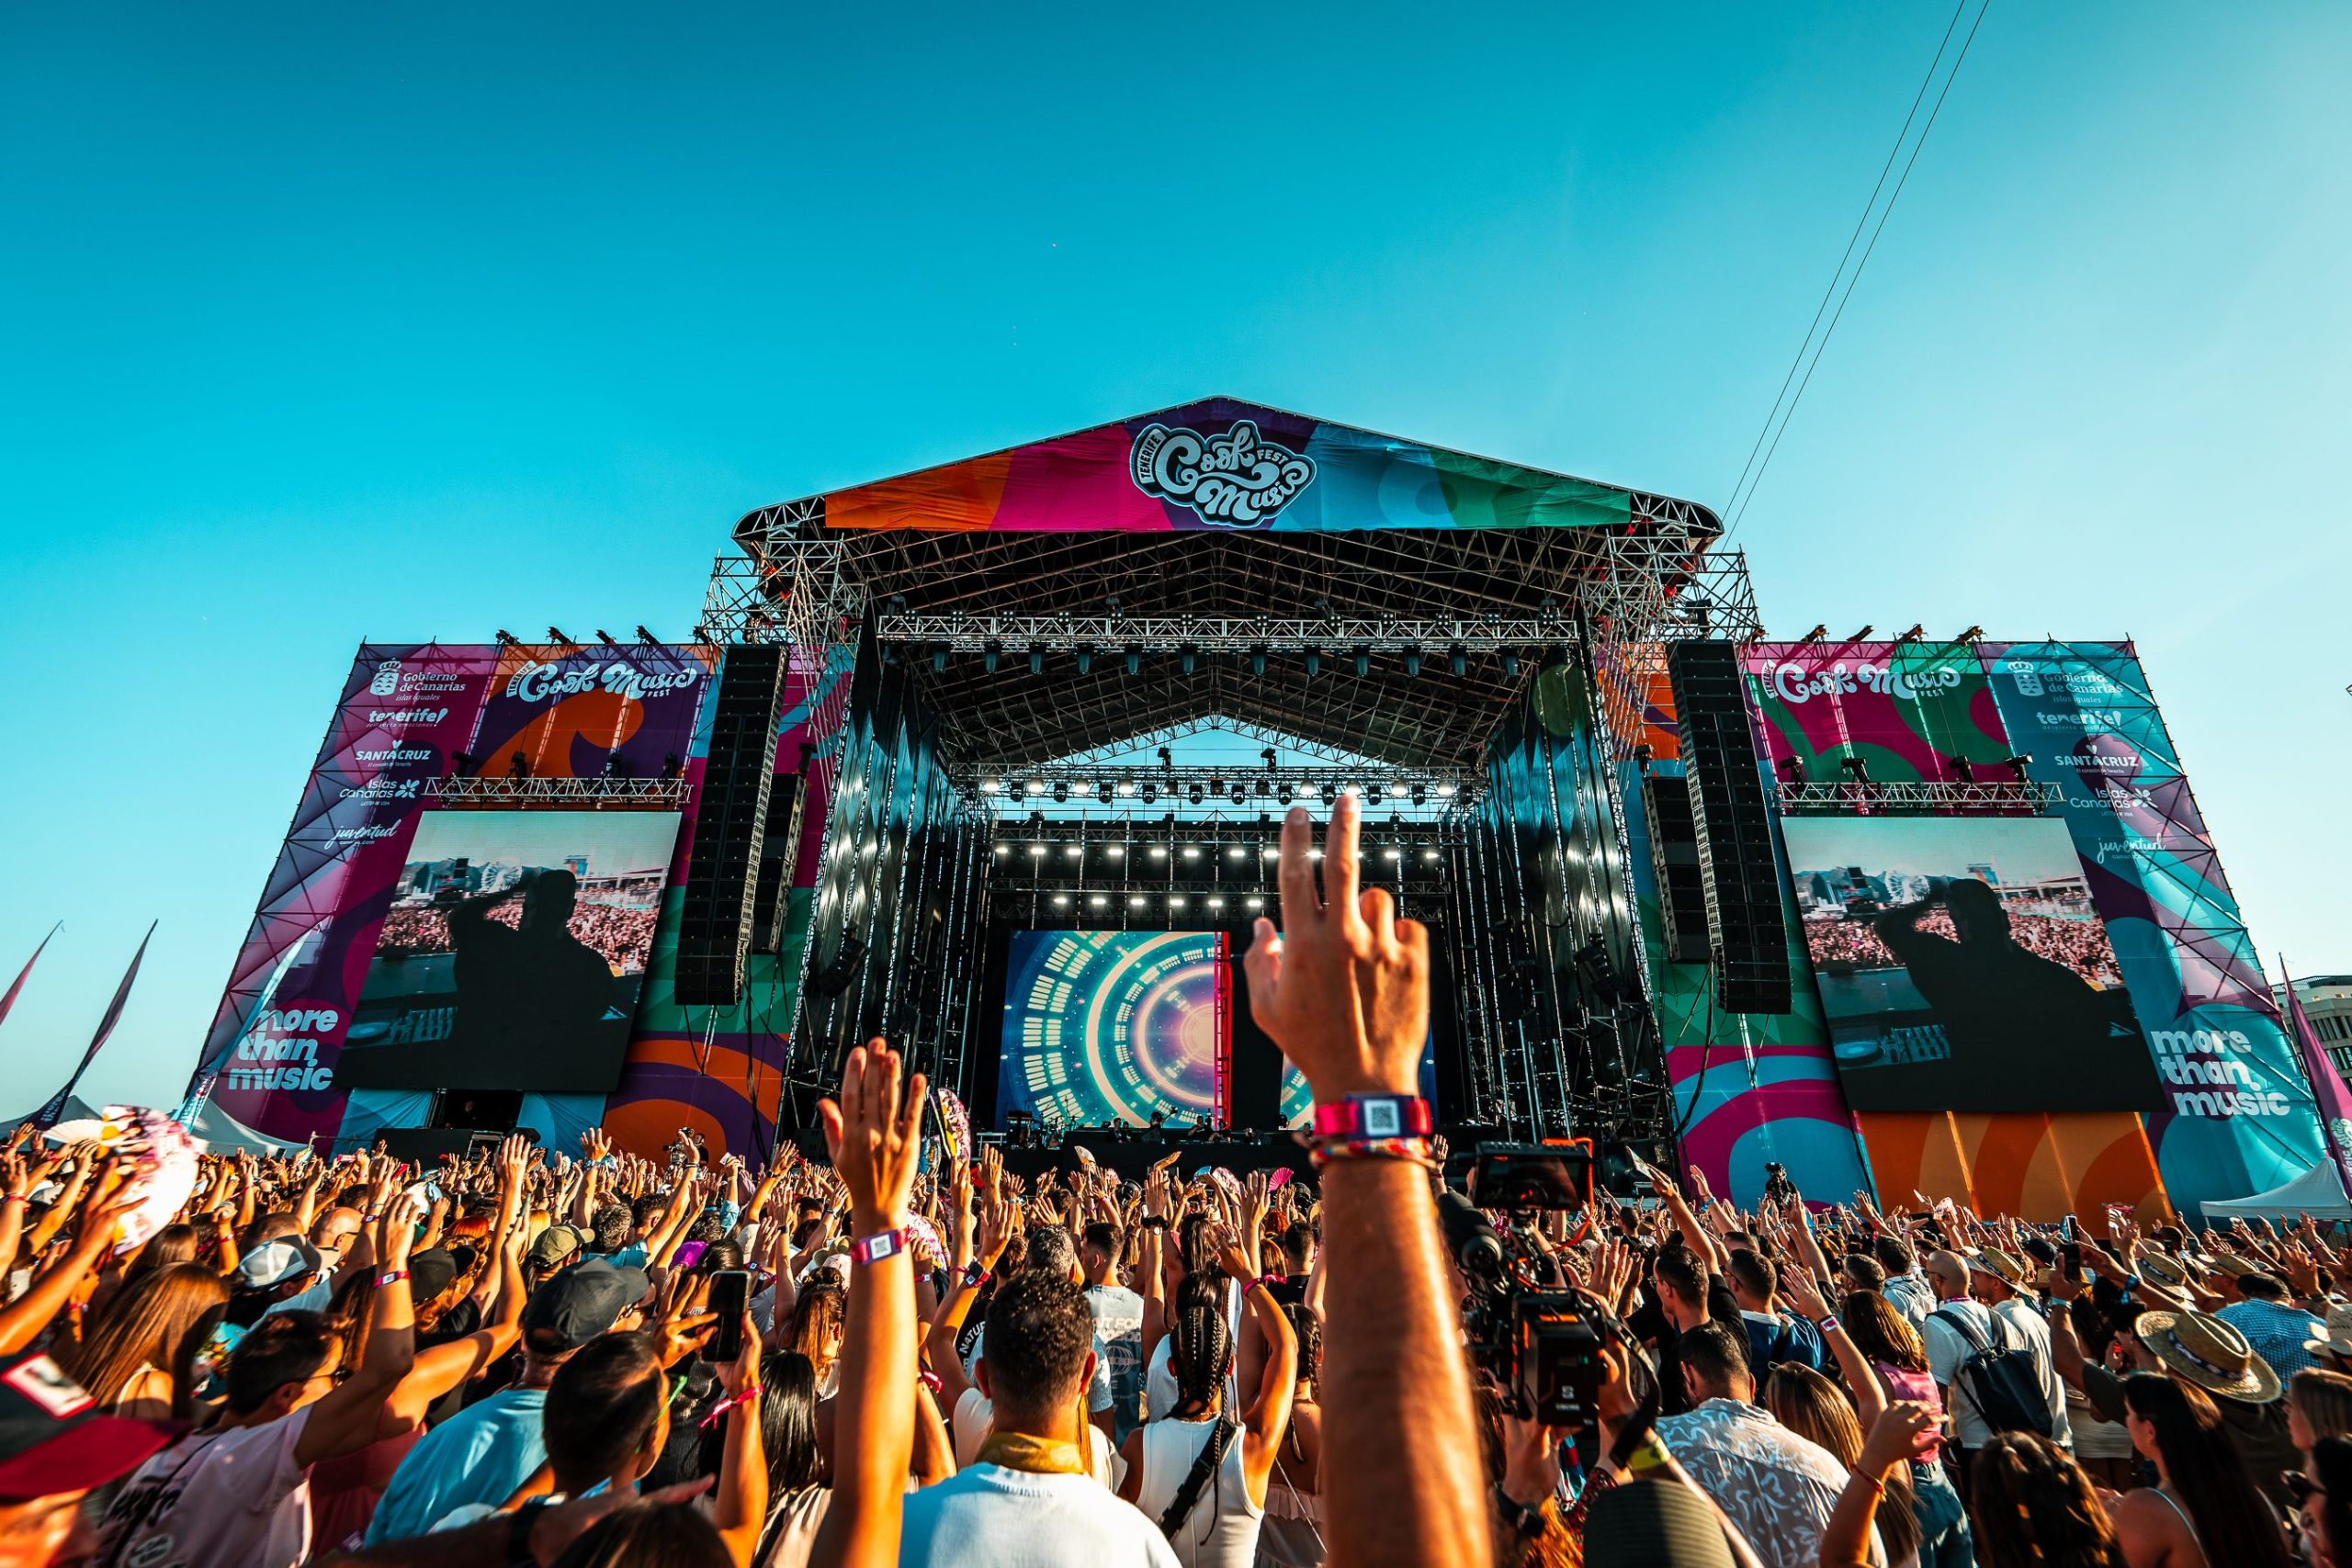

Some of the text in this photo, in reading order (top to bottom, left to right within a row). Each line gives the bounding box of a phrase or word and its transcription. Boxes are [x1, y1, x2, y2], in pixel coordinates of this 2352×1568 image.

[1138, 434, 1161, 479] TENERIFE
[1155, 426, 1257, 494] Cook
[1256, 448, 1288, 464] FEST
[1194, 460, 1310, 521] Music
[399, 682, 467, 692] de Canarias
[402, 671, 458, 682] Gobierno
[508, 664, 534, 694] TENERIFE
[518, 663, 697, 703] Cook Music
[1774, 662, 1961, 704] Cook Music
[2042, 672, 2108, 683] Gobierno
[2048, 682, 2124, 694] de Canarias
[395, 694, 413, 702] islas
[647, 689, 671, 698] FEST
[1919, 688, 1945, 697] FEST
[2052, 694, 2102, 705] islas iguales
[339, 788, 394, 799] Canarias
[368, 779, 398, 789] Islas
[2095, 787, 2129, 798] Islas
[2070, 797, 2132, 808] Canarias
[324, 819, 401, 850] juventud
[2097, 832, 2166, 864] juventud
[249, 1009, 339, 1032] more
[237, 1032, 319, 1061] than
[2150, 1030, 2253, 1055] more
[227, 1058, 334, 1091] music
[2159, 1054, 2254, 1085] than
[2173, 1082, 2291, 1117] music
